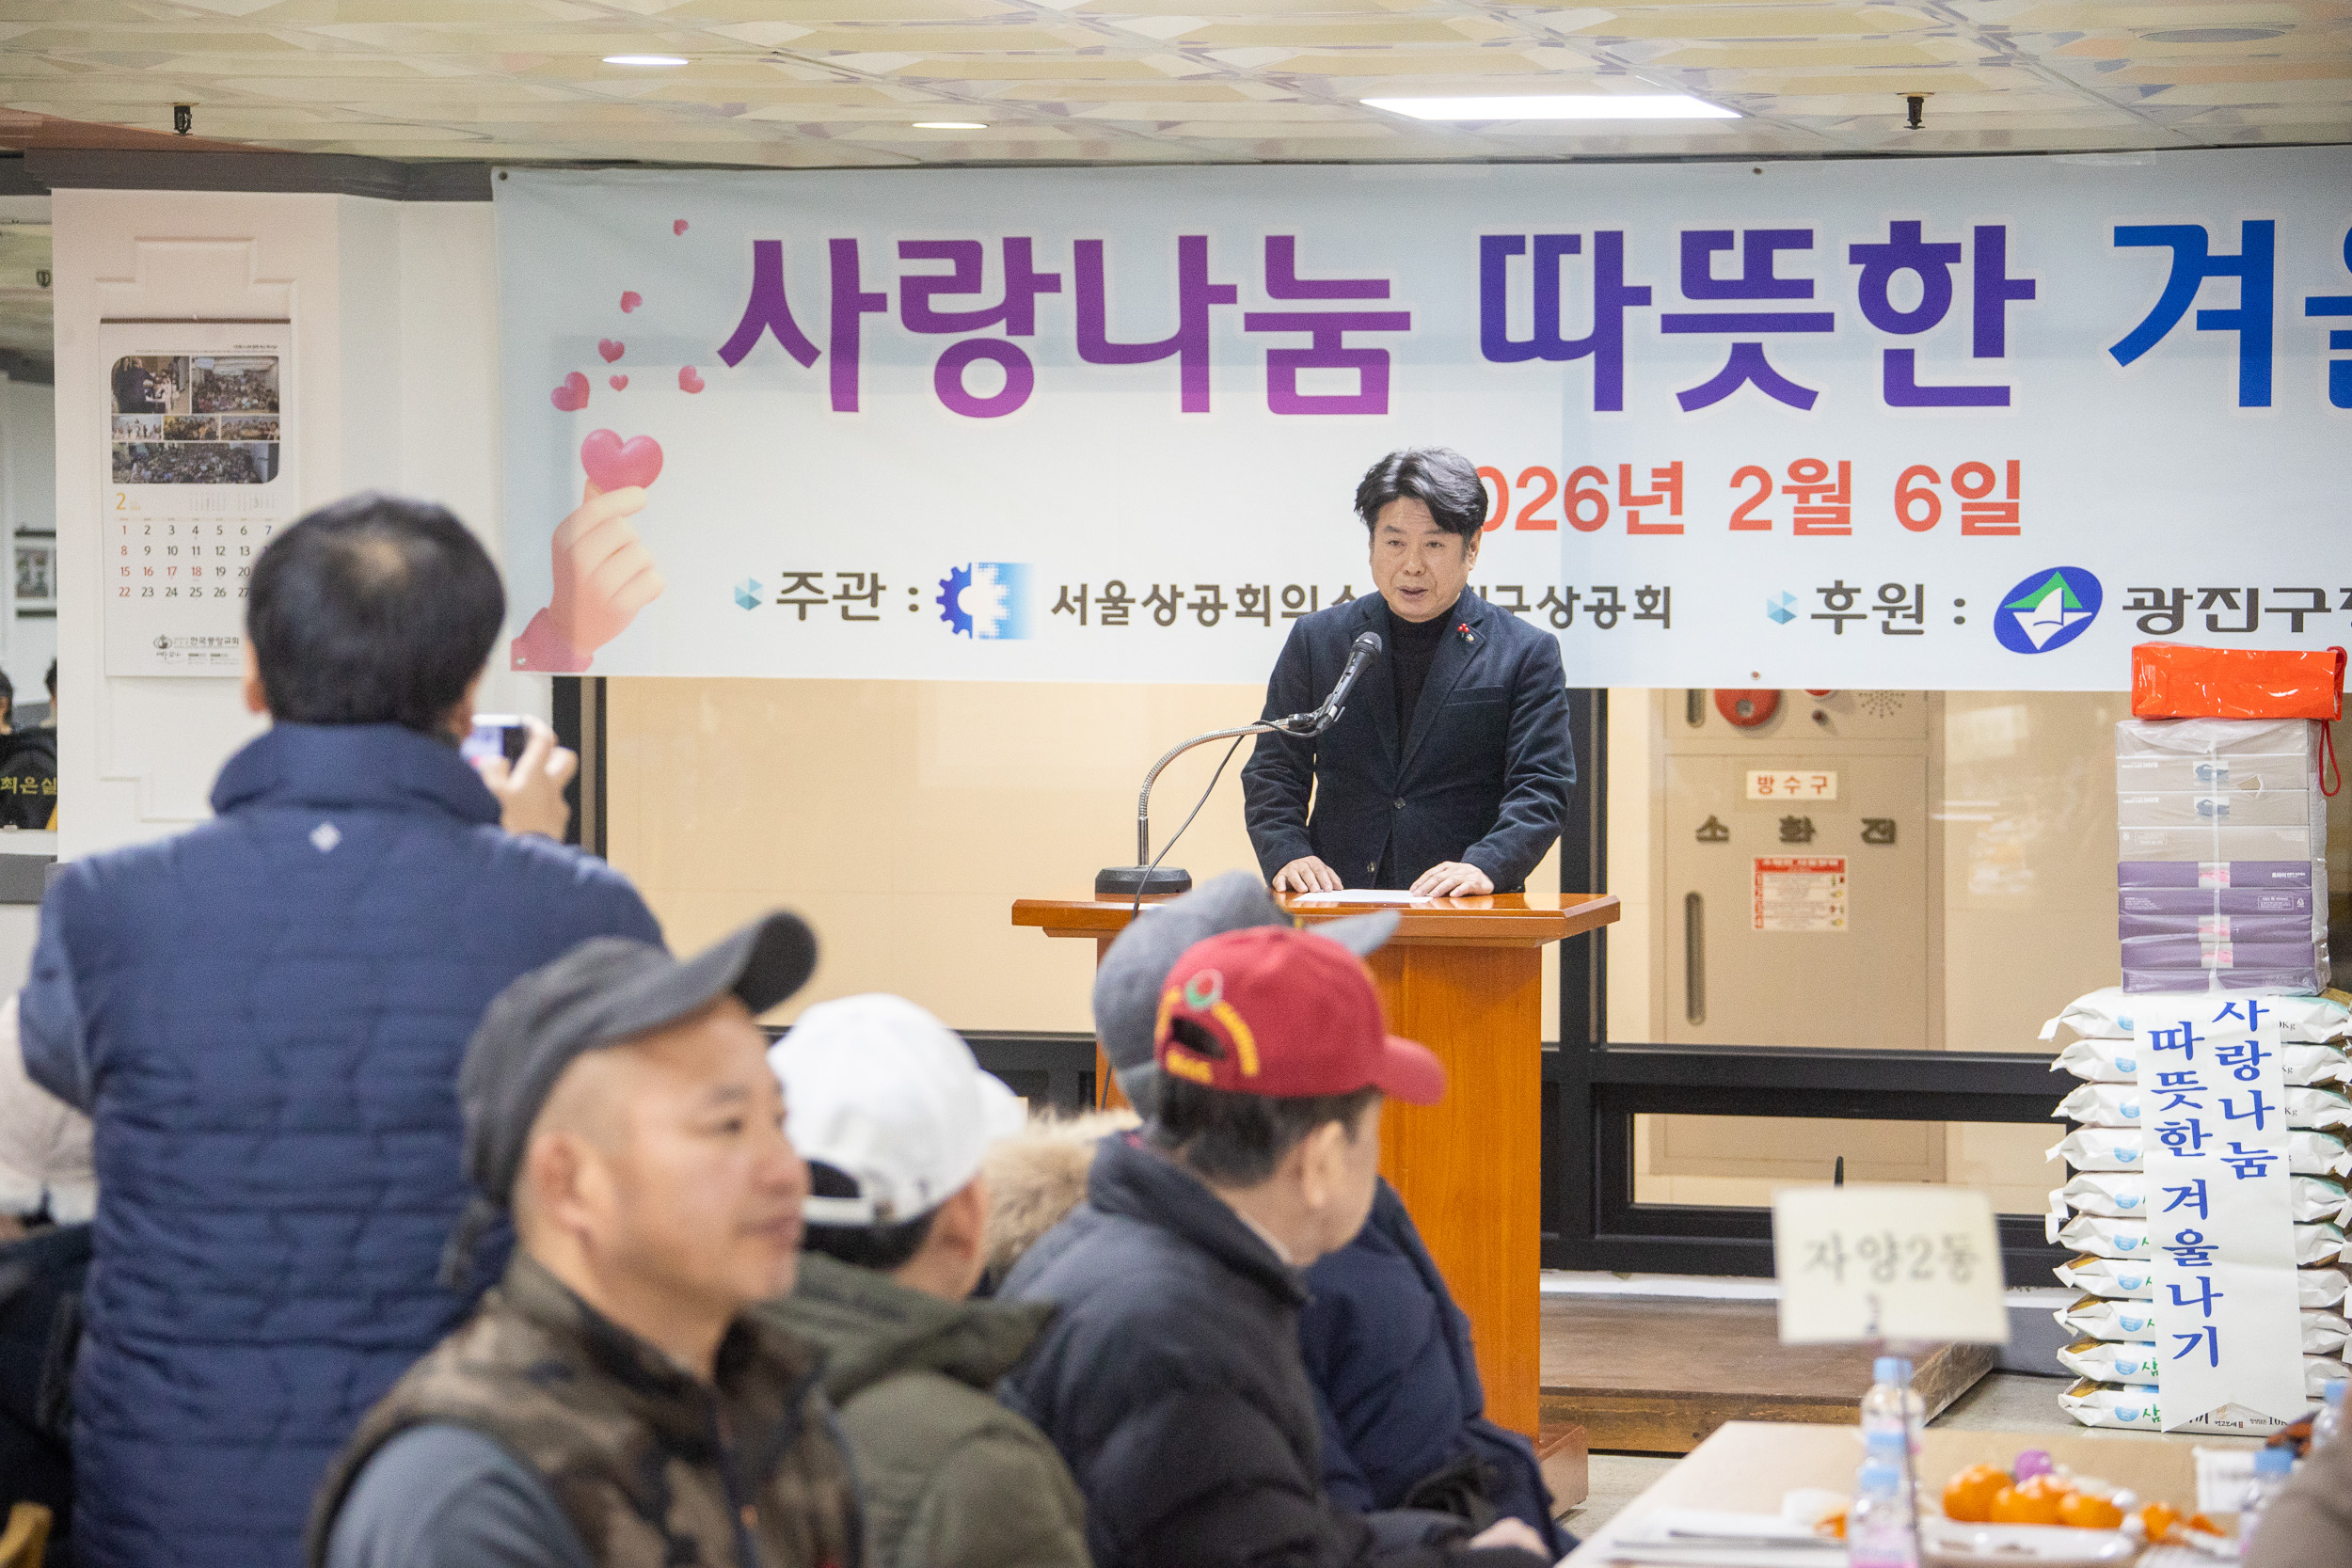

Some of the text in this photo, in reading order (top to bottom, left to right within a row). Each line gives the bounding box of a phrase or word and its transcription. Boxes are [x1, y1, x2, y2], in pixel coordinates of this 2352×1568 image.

[717, 219, 2352, 419] 사랑나눔 따뜻한 겨
[116, 492, 126, 511] 2
[1475, 457, 2022, 536] 026년 2월 6일
[120, 546, 250, 556] 8 9 10 11 12 13
[144, 525, 151, 535] 2
[168, 525, 175, 535] 3
[192, 525, 199, 535] 4
[216, 525, 223, 535] 5
[240, 525, 247, 535] 6
[264, 525, 272, 535] 7
[119, 587, 249, 597] 22 23 24 25 26 27
[120, 566, 250, 577] 15 16 17 18 19 20
[776, 572, 887, 621] 주관
[1470, 584, 1671, 629] 구상공회
[1811, 579, 1925, 635] 후원
[2122, 587, 2352, 635] 광진구
[1757, 775, 1828, 796] 방수구
[1695, 815, 1897, 845] 소화전
[2212, 999, 2278, 1180] 사랑나눔
[2147, 1021, 2224, 1368] 따뜻한 겨울나기
[1800, 1229, 1982, 1285] 자양2동
